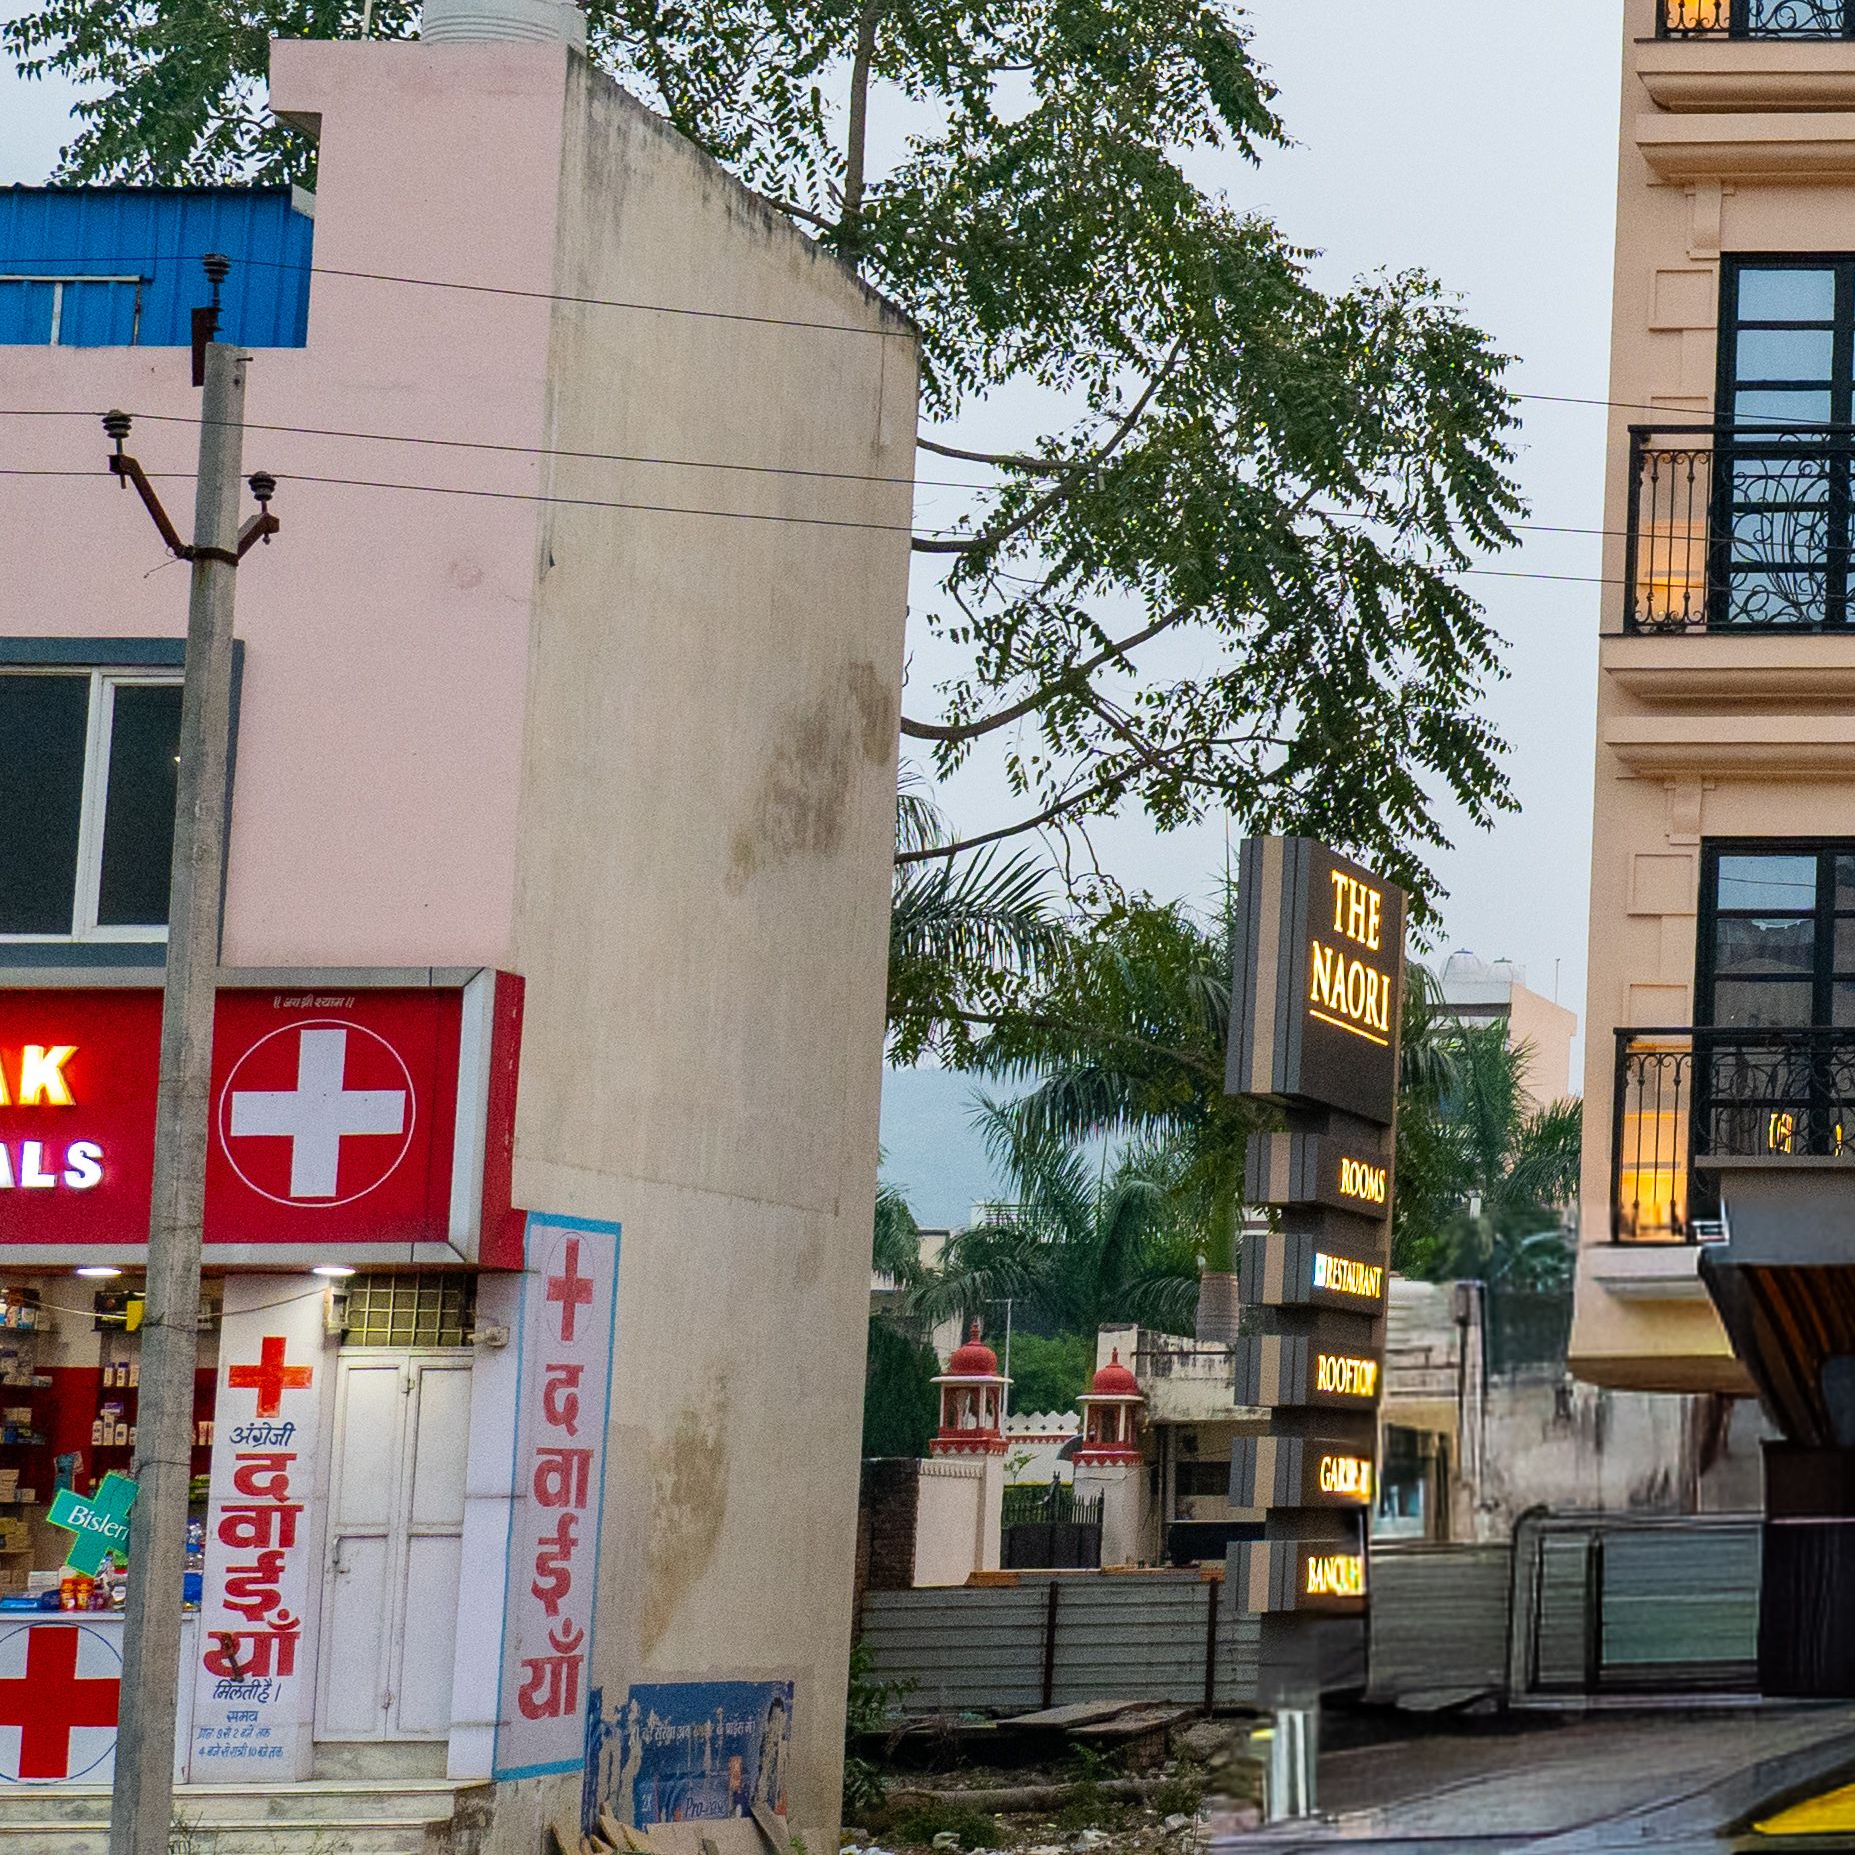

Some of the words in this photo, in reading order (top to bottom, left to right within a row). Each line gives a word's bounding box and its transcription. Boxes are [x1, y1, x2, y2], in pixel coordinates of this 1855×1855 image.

[1331, 868, 1382, 951] THE
[1311, 940, 1391, 1032] NAORI
[0, 1044, 80, 1106] K
[1340, 1157, 1386, 1205] ROOMS
[1325, 1255, 1383, 1299] RESTAURANT
[1317, 1354, 1378, 1397] ROOFTOP
[229, 1421, 297, 1448] अंग्रेजी
